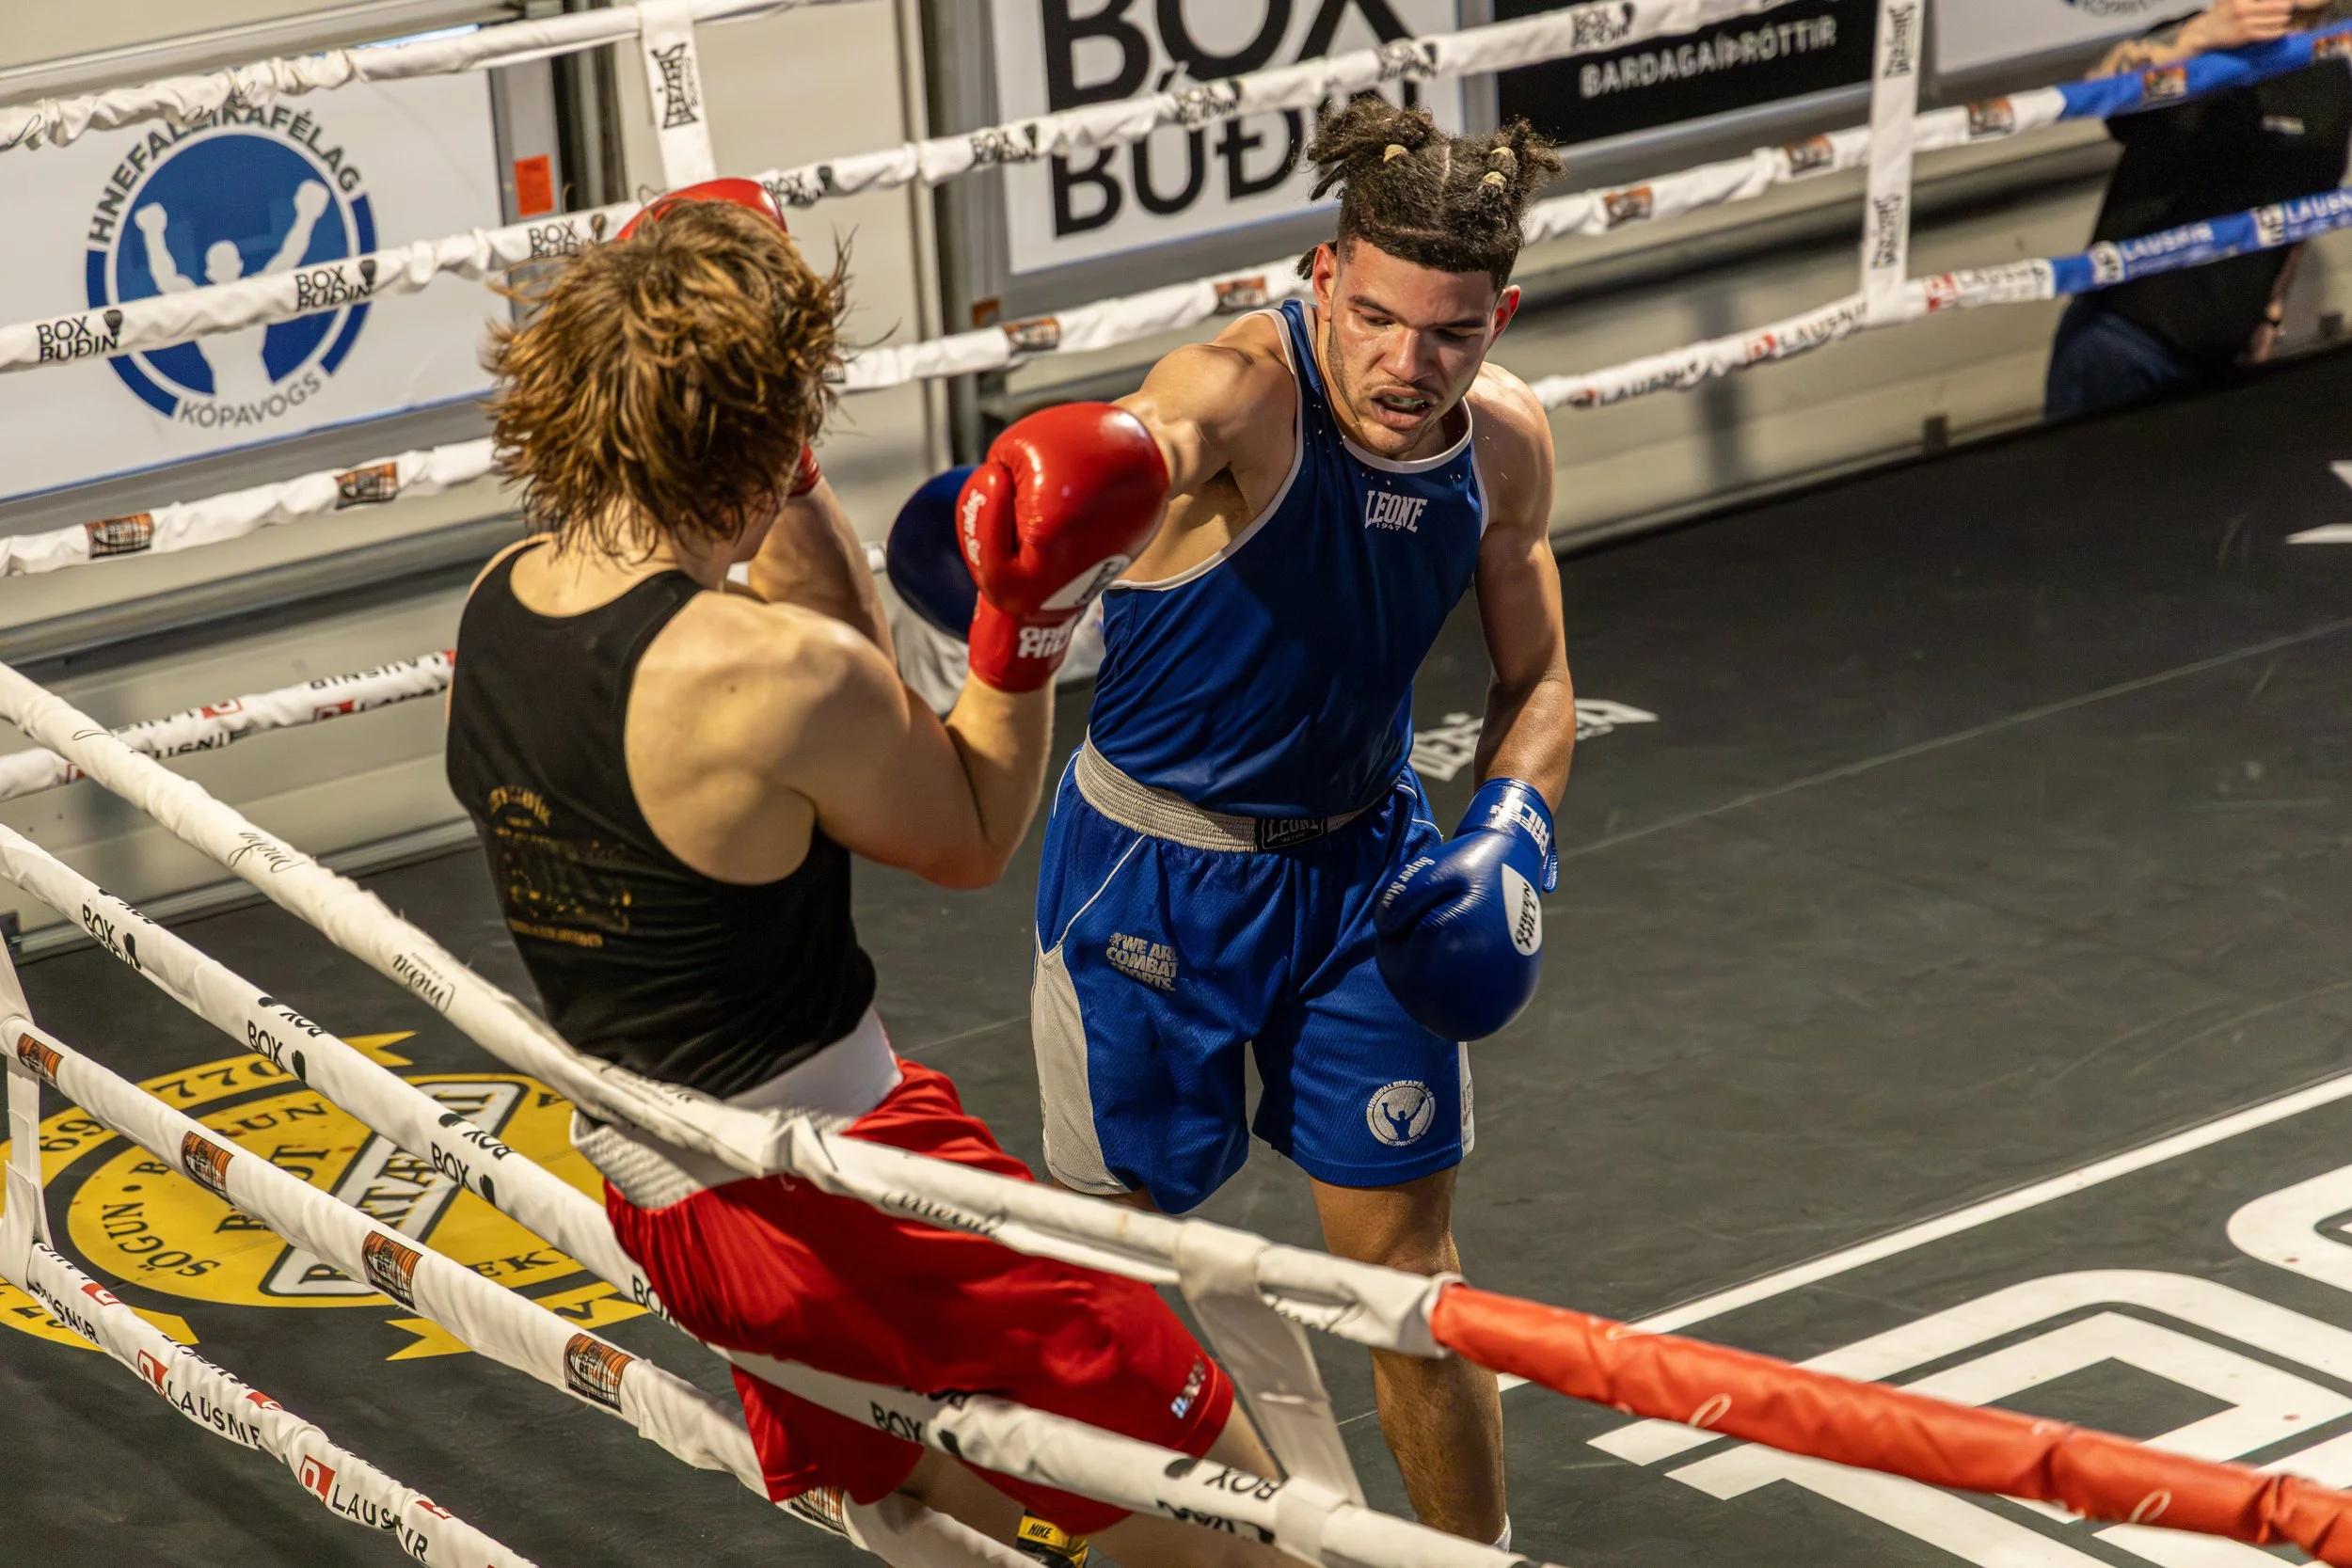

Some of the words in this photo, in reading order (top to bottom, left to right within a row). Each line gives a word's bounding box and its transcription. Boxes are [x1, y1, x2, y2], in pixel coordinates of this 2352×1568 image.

[294, 265, 347, 295] BOX
[37, 316, 92, 346] BOX
[180, 372, 322, 428] KÓPAVOGS
[1365, 490, 1428, 533] LEONE
[1376, 522, 1401, 531] 1947
[1401, 856, 1437, 882] Super
[1381, 880, 1407, 908] Star
[82, 903, 119, 950] BOX
[1106, 946, 1179, 978] COMBAT
[247, 1020, 288, 1072] BOX
[128, 1102, 328, 1176] BUN
[431, 1141, 475, 1195] BOX
[102, 1202, 222, 1277] SÖGUN
[1028, 1523, 1053, 1539] NIKE
